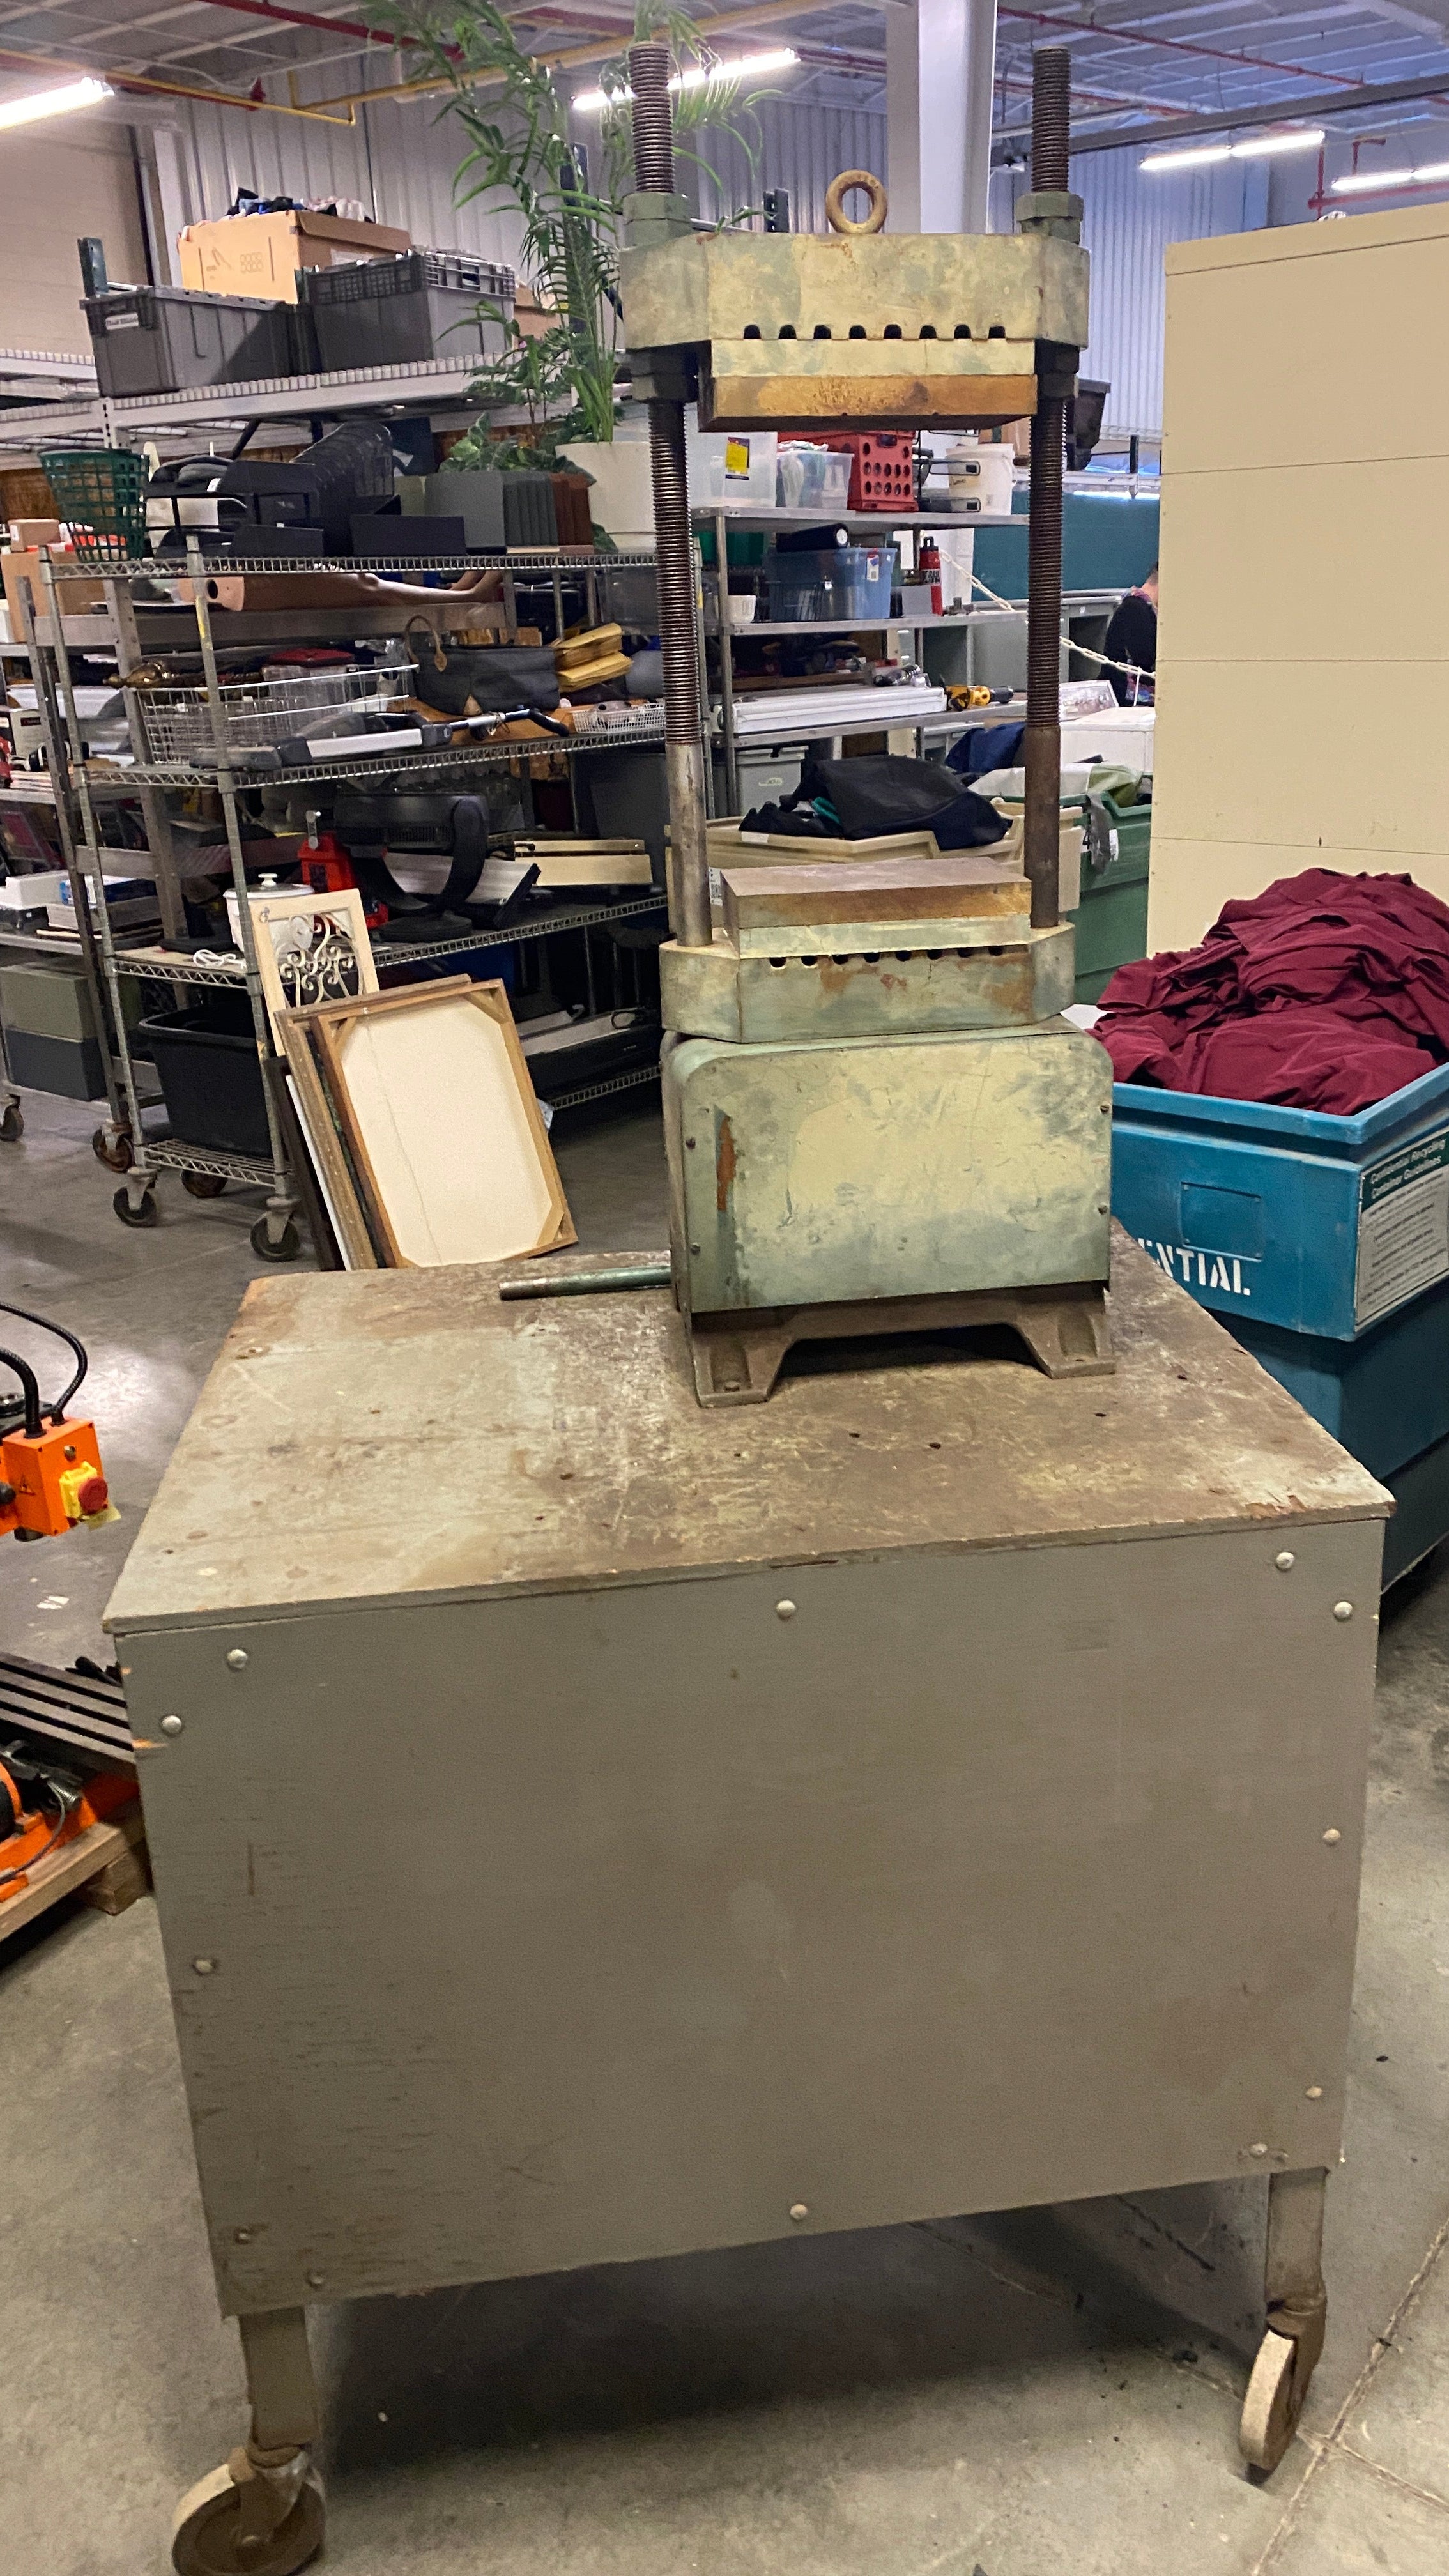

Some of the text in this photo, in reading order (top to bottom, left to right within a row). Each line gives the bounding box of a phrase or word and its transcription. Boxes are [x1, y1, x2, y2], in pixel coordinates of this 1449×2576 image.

[1371, 1138, 1446, 1184] Confidential Recycling
[1371, 1156, 1441, 1199] Container Guidelines
